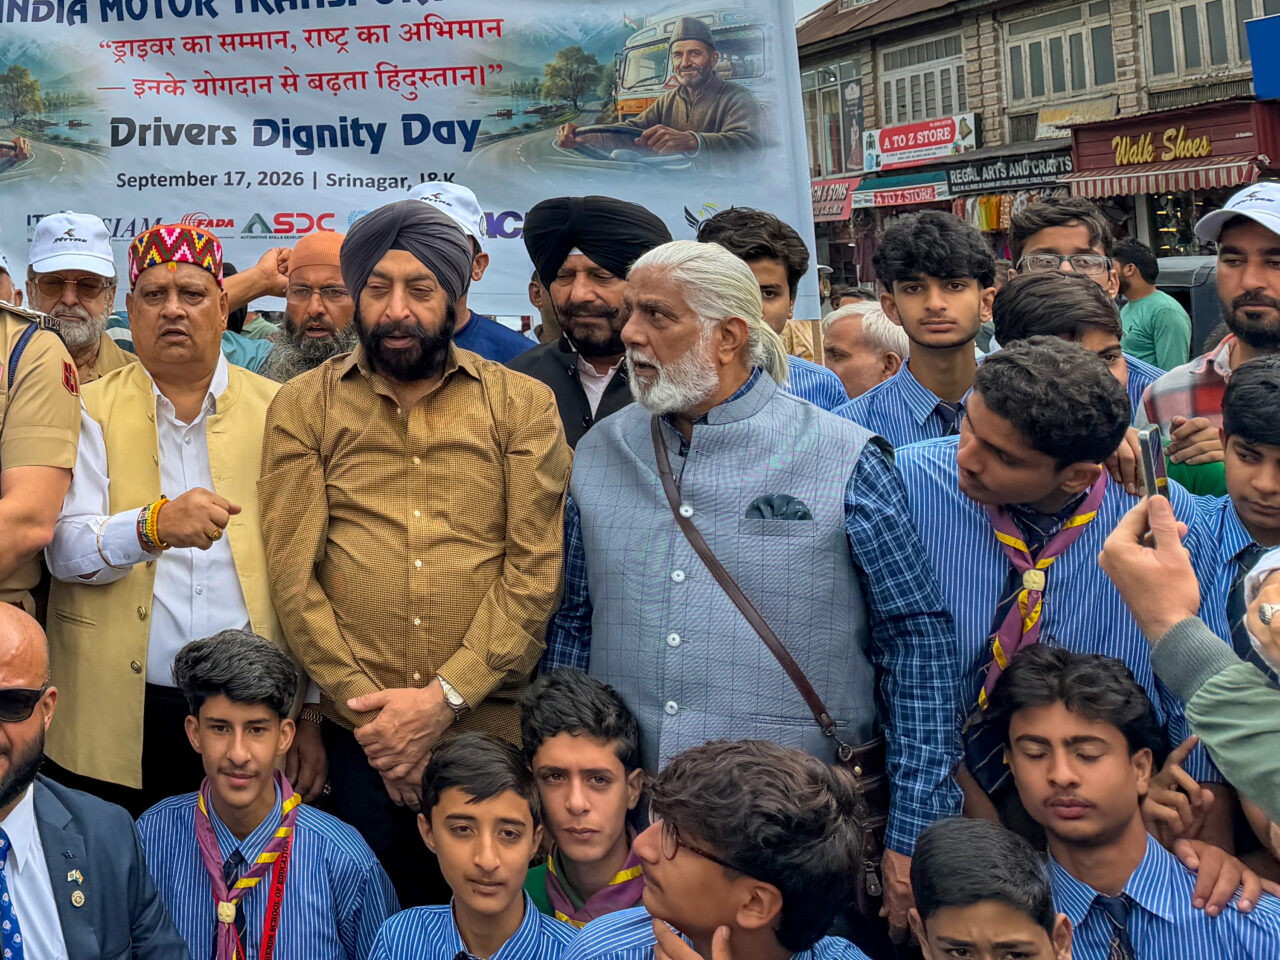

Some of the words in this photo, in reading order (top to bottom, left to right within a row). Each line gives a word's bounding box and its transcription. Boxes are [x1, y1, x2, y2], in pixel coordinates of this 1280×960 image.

[181, 35, 212, 55] का
[219, 30, 297, 54] सम्मान,
[302, 25, 350, 54] राष्ट्र
[356, 24, 391, 44] का
[398, 12, 504, 42] अभिमान
[132, 71, 186, 100] इनके
[192, 69, 272, 98] योगदान
[279, 66, 300, 95] से
[306, 69, 368, 98] बढ़ता
[110, 115, 237, 147] Drivers
[252, 116, 386, 156] Dignity
[401, 113, 482, 152] Day
[883, 137, 891, 149] A
[892, 134, 906, 148] TO
[908, 133, 915, 145] Z
[917, 127, 951, 144] STORE
[1112, 131, 1156, 166] Walk
[1161, 124, 1212, 161] Shoes
[116, 170, 218, 191] September
[223, 171, 251, 189] 17,
[257, 171, 305, 186] 2026
[326, 172, 412, 191] Srinagar,
[950, 167, 980, 184] REGAL
[982, 165, 1007, 180] ARTS
[1009, 162, 1031, 177] AND
[1032, 155, 1073, 175] CRAFTS
[875, 193, 883, 205] A
[883, 192, 896, 204] TO
[896, 191, 904, 202] Z
[904, 189, 934, 202] STORE
[197, 218, 234, 228] FADA
[277, 840, 290, 885] EDUCATION
[274, 886, 282, 898] OF
[270, 900, 280, 934] SCHOOL
